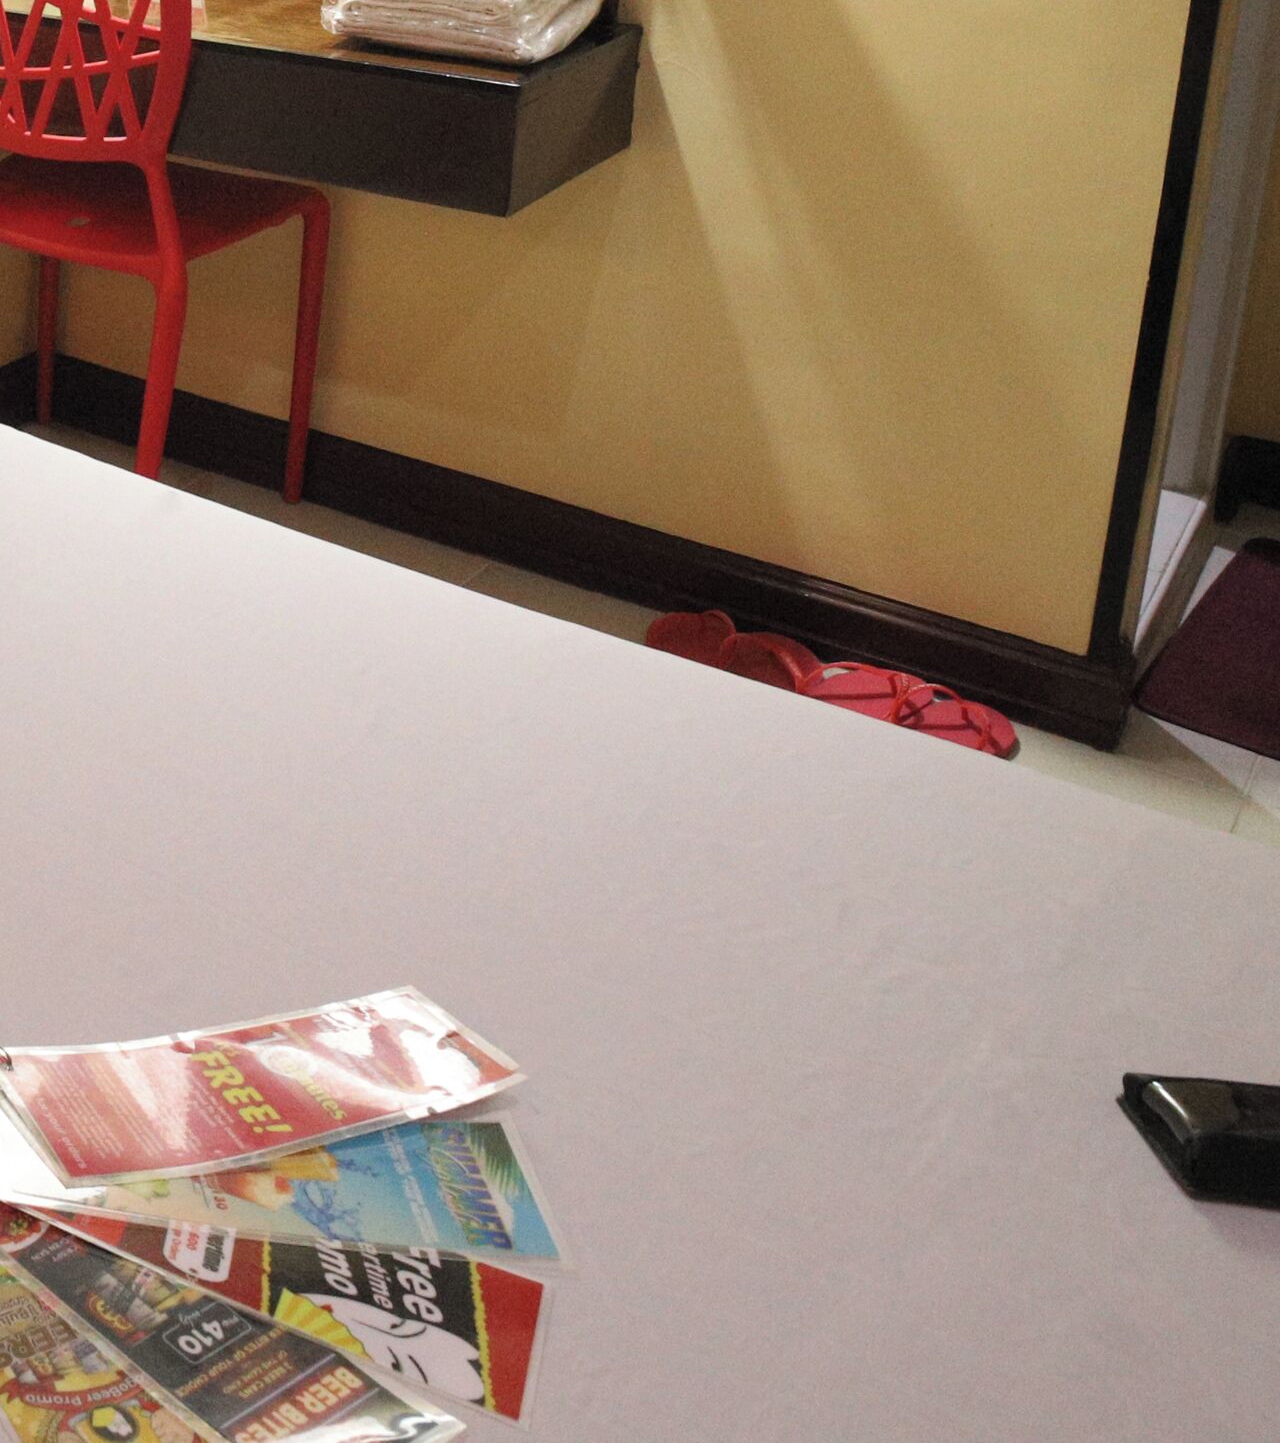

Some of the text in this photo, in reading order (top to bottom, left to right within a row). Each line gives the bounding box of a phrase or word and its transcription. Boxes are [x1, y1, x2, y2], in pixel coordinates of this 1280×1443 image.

[189, 1050, 293, 1134] FREE!
[358, 1241, 394, 1310] ertime
[391, 1245, 444, 1323] Free
[178, 1320, 225, 1355] 410
[25, 1393, 82, 1407] Promo
[235, 1366, 364, 1443] BEER BITES
